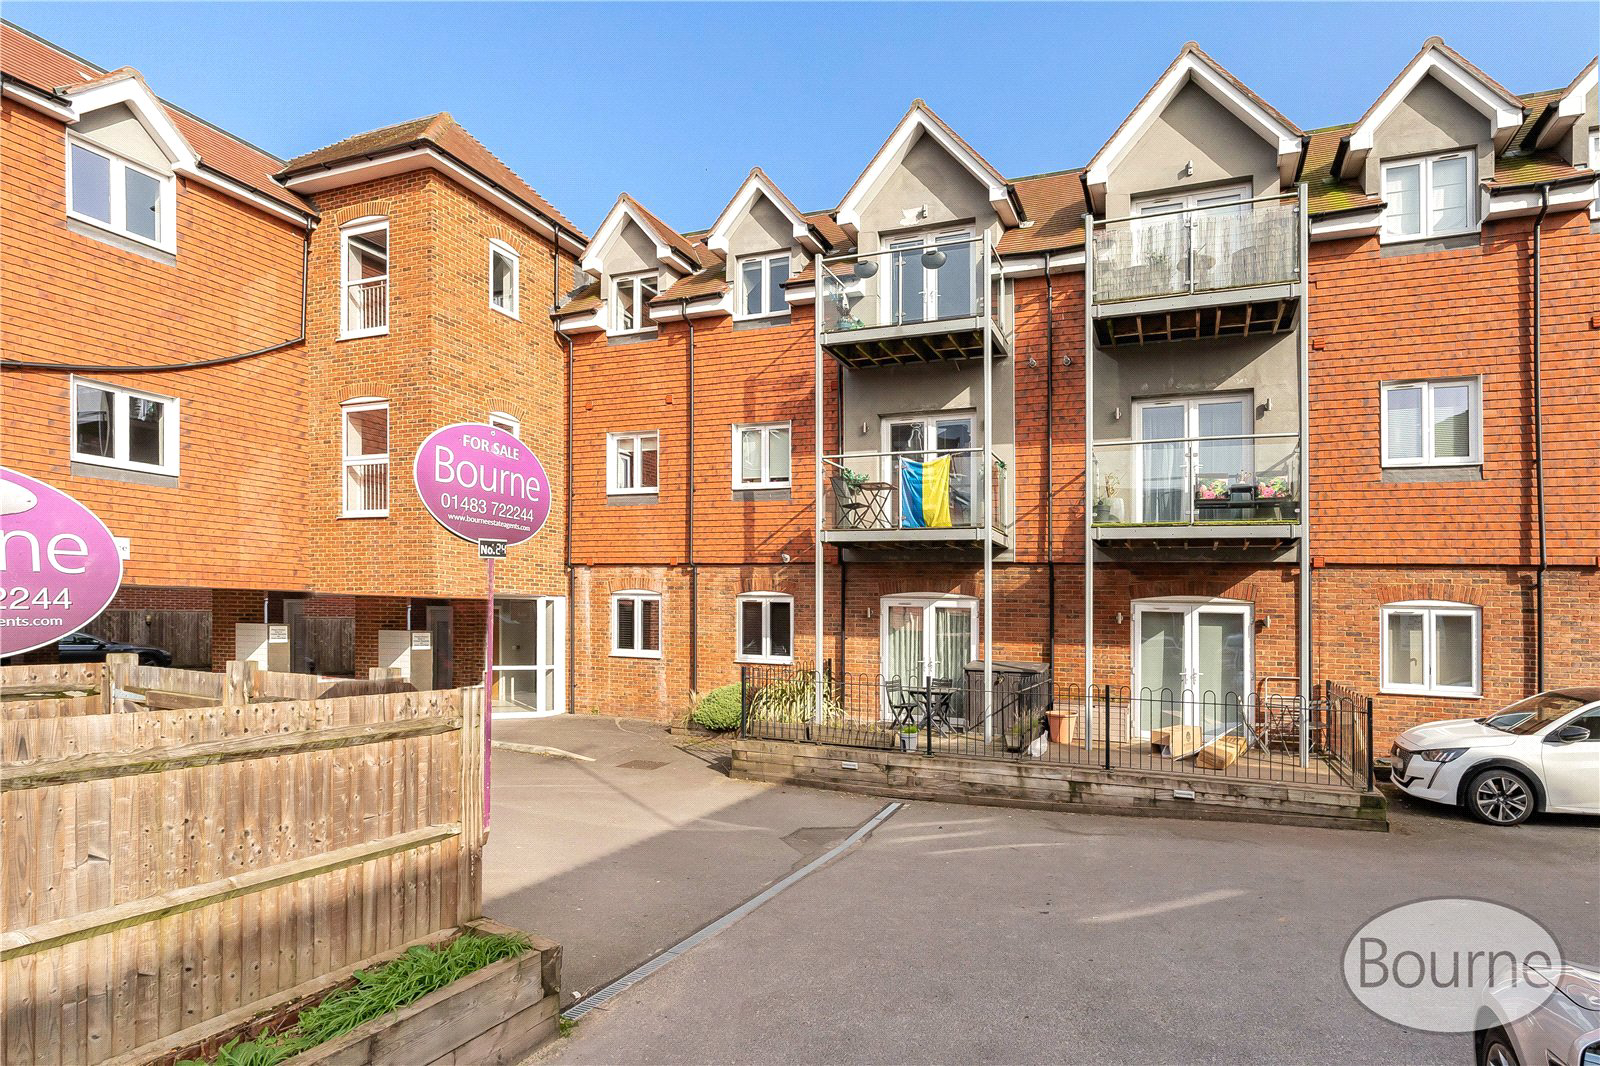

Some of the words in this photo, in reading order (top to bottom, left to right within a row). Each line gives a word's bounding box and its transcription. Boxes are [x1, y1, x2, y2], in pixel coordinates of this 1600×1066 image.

[462, 434, 490, 453] FOR
[491, 442, 520, 461] SALE
[434, 444, 541, 502] Bourne
[440, 492, 487, 514] 01483
[491, 501, 534, 523] 722244
